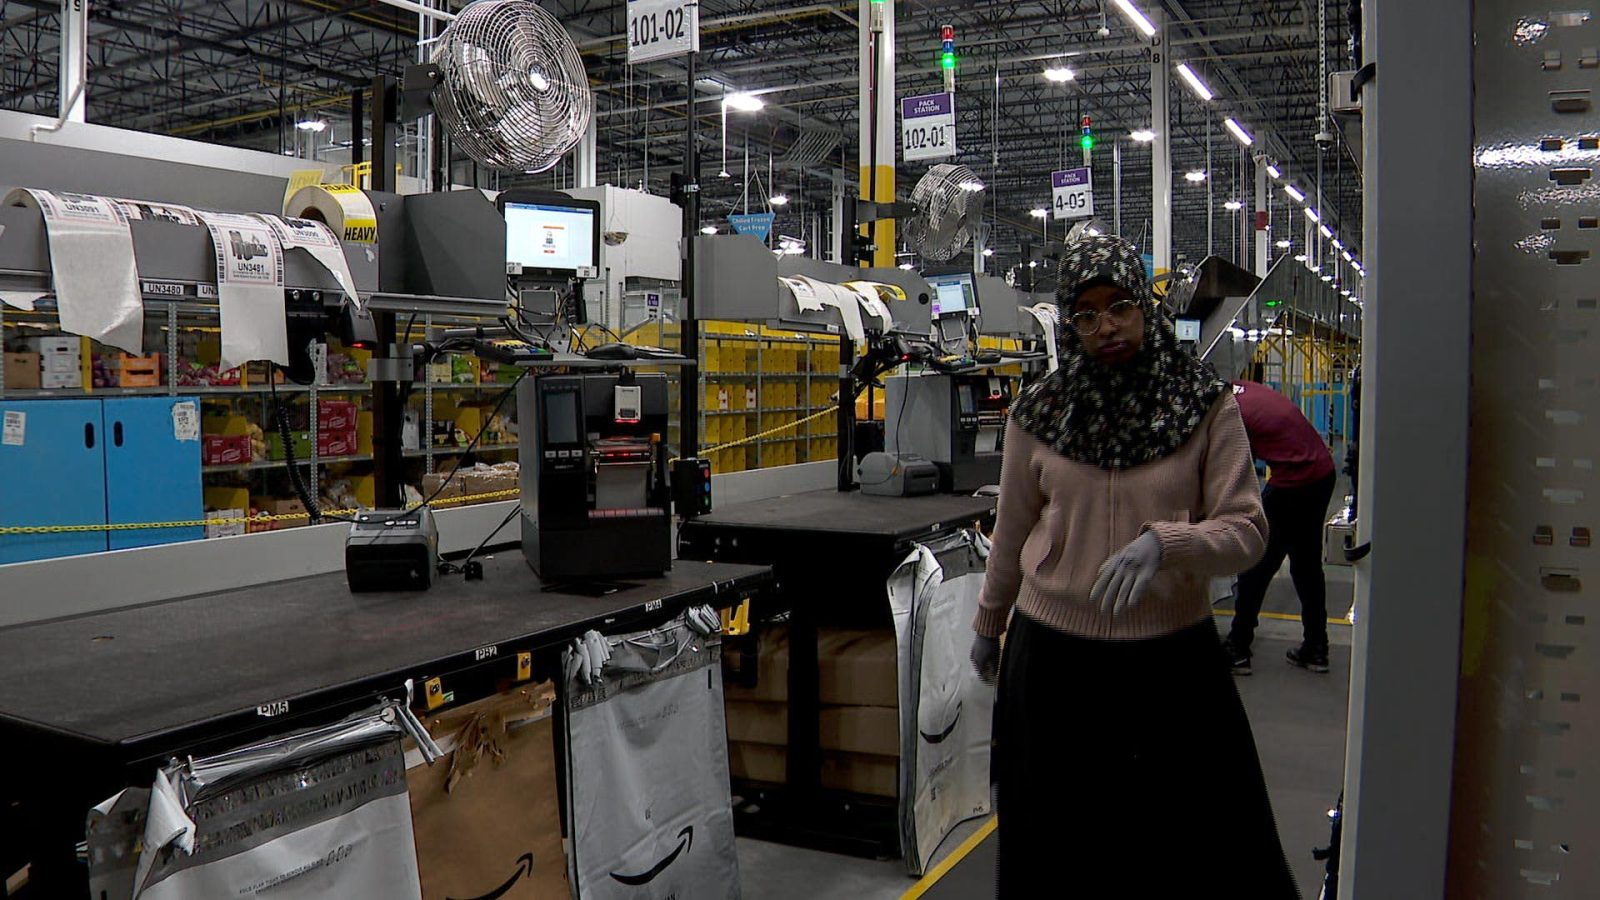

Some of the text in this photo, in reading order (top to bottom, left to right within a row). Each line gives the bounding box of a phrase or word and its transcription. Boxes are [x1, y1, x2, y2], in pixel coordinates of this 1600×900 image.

[631, 6, 684, 47] 101-02
[1152, 52, 1161, 64] 8
[918, 99, 935, 107] PACK
[913, 105, 940, 114] STATION
[905, 126, 946, 149] 102-01
[1055, 192, 1086, 211] 4-05
[343, 226, 376, 241] HEAVY
[237, 262, 265, 273] UN3481
[148, 284, 181, 295] UN3480
